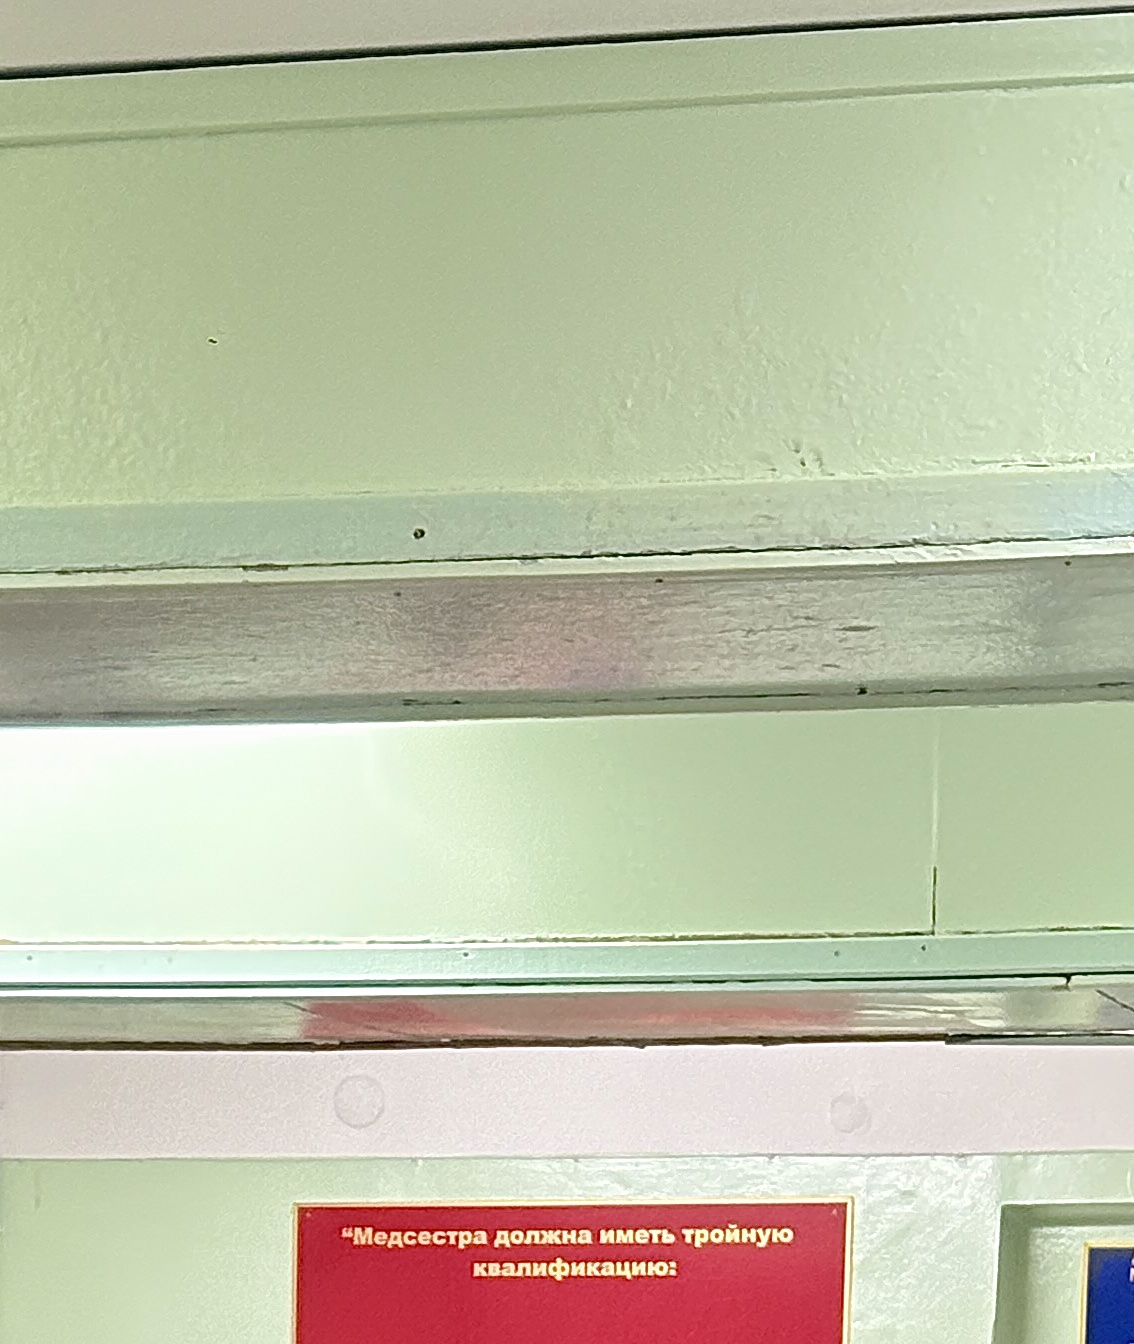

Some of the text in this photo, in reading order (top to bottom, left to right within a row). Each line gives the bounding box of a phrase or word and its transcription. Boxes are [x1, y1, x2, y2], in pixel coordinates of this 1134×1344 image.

[341, 1223, 794, 1249] “Медсестра должна иметь тройную
[472, 1256, 677, 1281] квалификацию:
